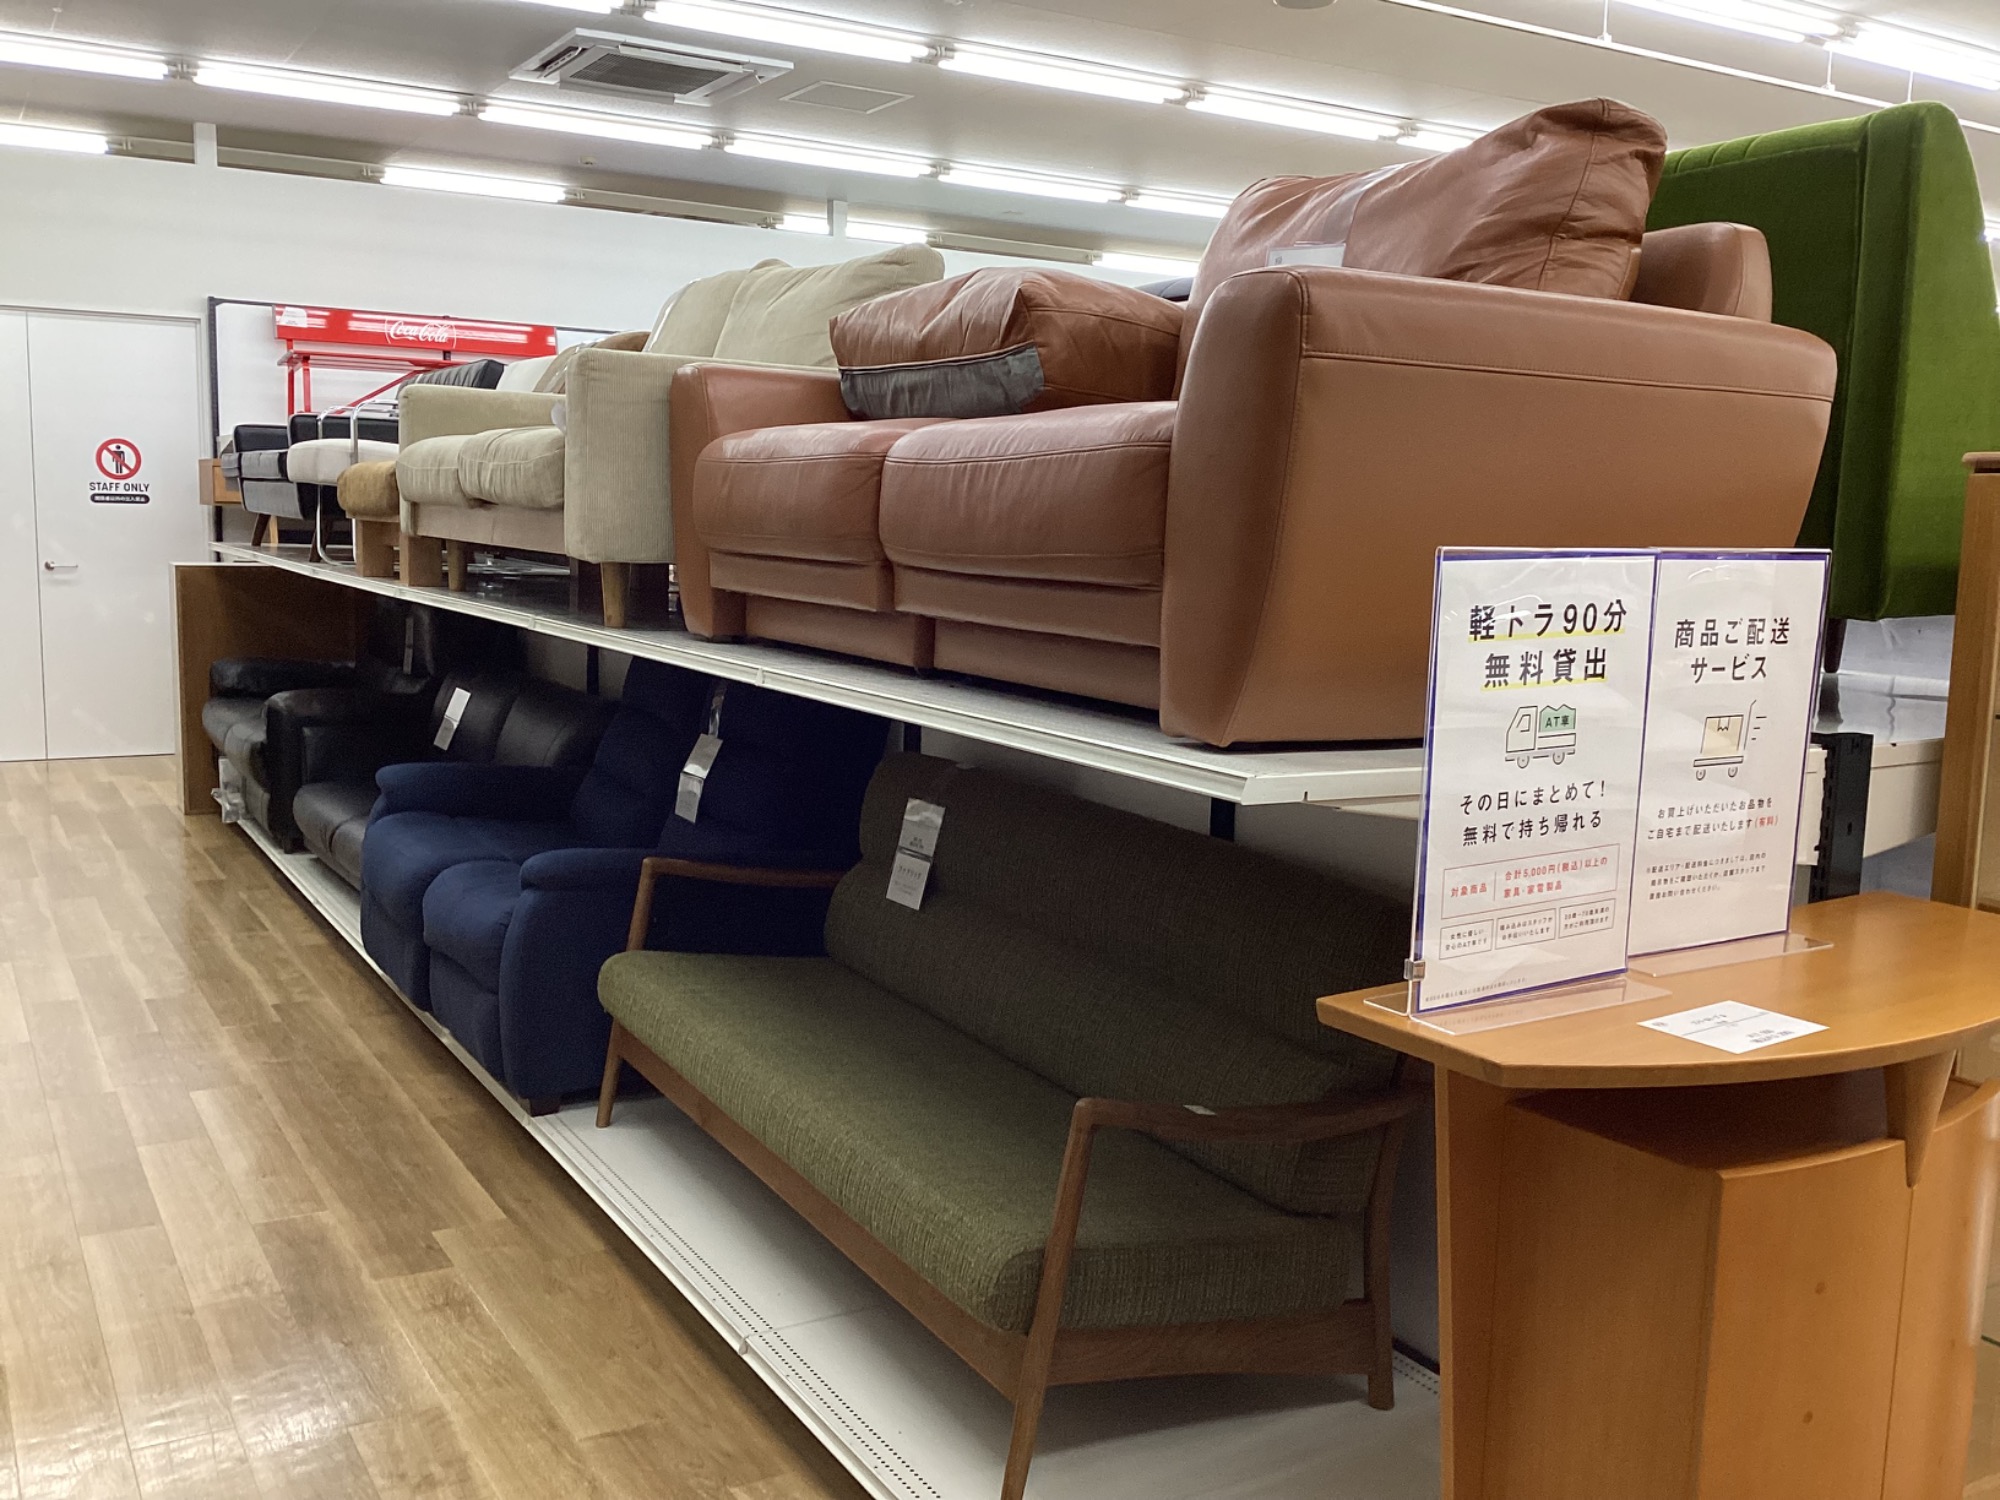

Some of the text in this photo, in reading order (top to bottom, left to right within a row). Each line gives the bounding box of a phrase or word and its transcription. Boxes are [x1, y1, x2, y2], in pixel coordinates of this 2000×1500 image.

[89, 481, 150, 493] STAFF ONLY
[1469, 599, 1627, 641] 軽トラ90分
[1674, 617, 1790, 648] 商品ご配送
[1484, 647, 1606, 688] 無料貸出
[1690, 653, 1767, 684] サービス
[1545, 715, 1569, 728] AT車
[1459, 780, 1606, 815] その日にまとめて！
[1657, 797, 1772, 819] お買上げいただいたお品物を
[1462, 810, 1602, 847] 無料で持ち帰れる
[1450, 882, 1487, 898] 対象商品
